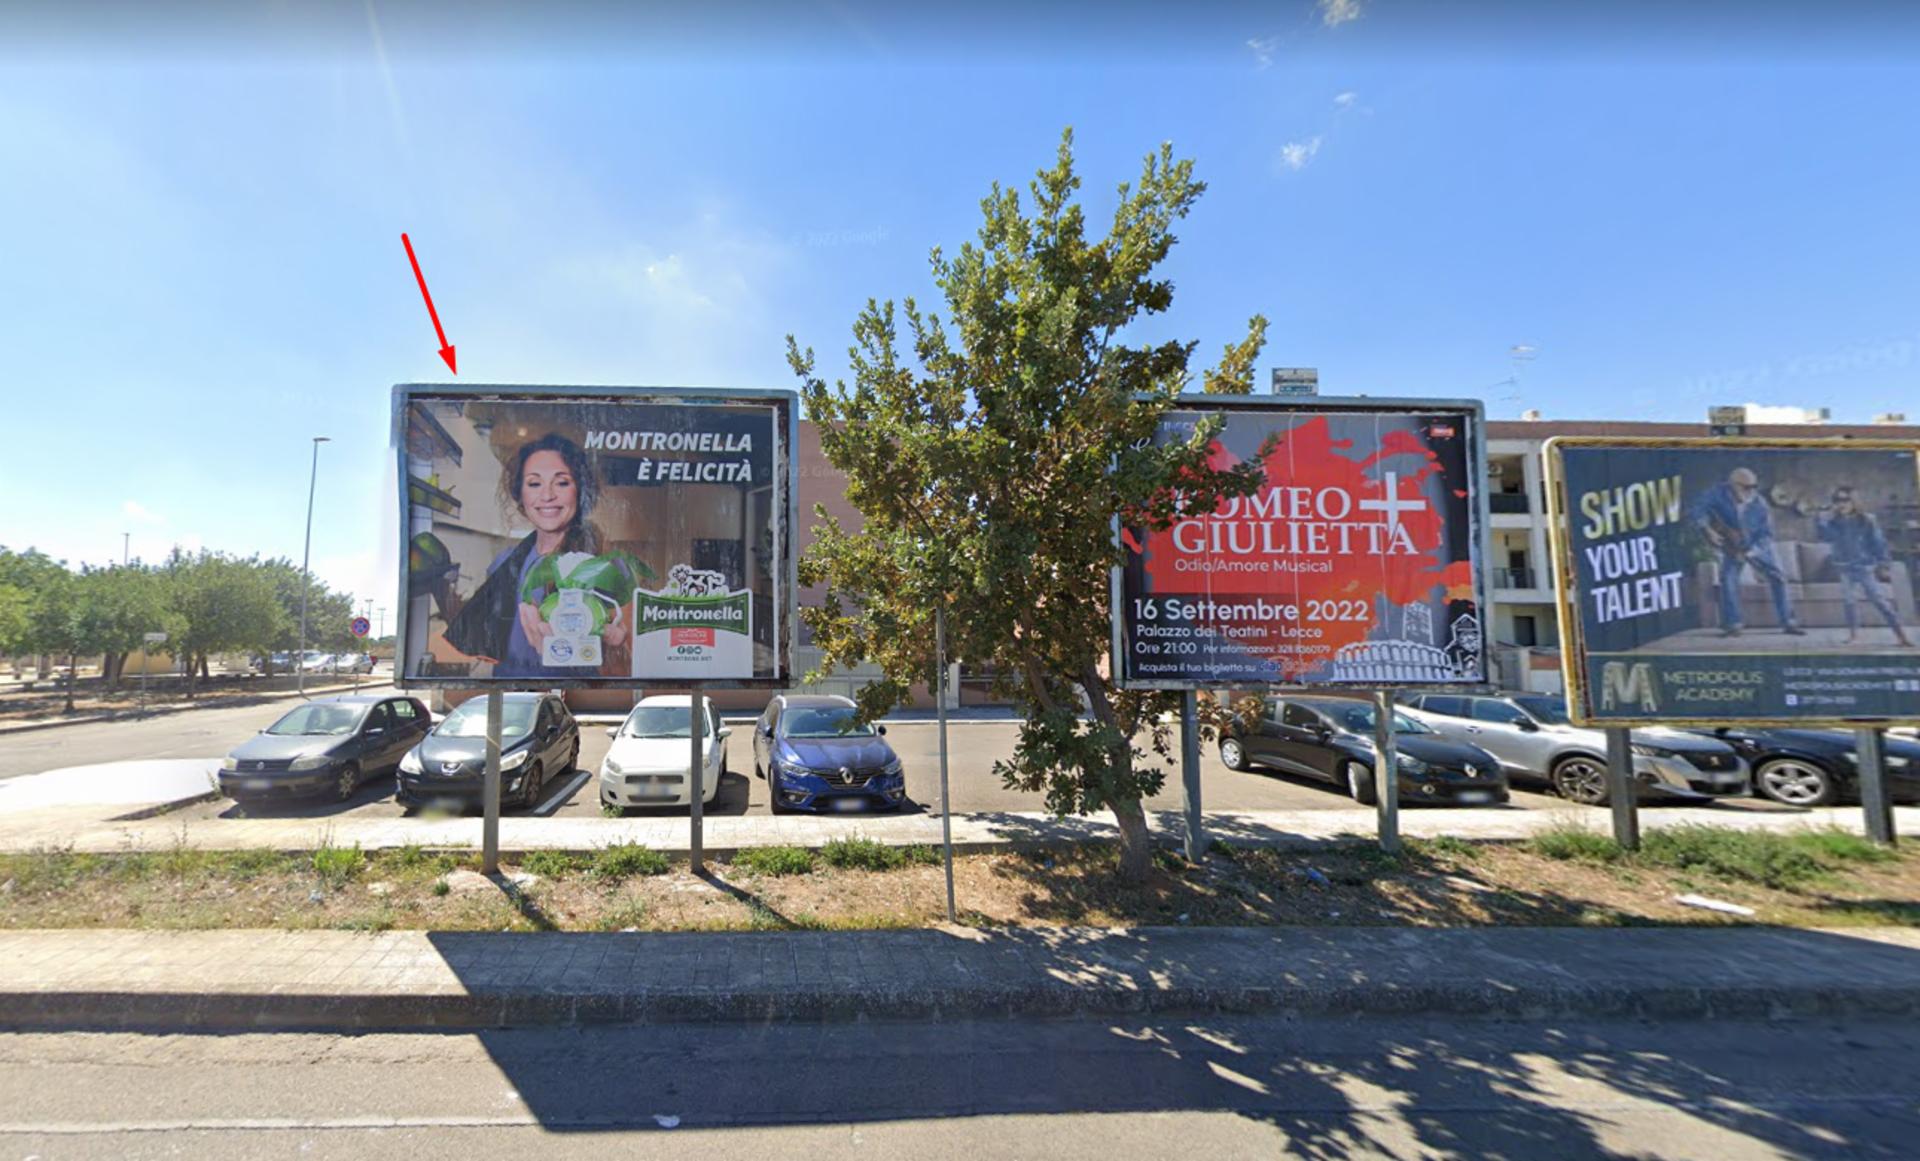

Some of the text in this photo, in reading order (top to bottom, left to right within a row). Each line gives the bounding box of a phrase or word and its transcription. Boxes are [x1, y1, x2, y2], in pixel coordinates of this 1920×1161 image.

[584, 431, 753, 453] MONTRONELLA
[637, 458, 651, 482] È
[656, 458, 753, 482] FELICITÀ
[1175, 487, 1351, 520] OMEO
[1580, 475, 1683, 541] SHOW
[1171, 521, 1420, 556] GIULIETTA
[1273, 558, 1334, 573] Musical
[1585, 536, 1658, 582] YOUR
[1590, 571, 1684, 624] TALENT
[642, 605, 743, 622] Montronella
[1134, 599, 1369, 622] 16 Settembre 2022
[1136, 624, 1191, 638] Palazzo
[1220, 624, 1268, 638] Teatini
[1281, 625, 1324, 638] Lecce
[1135, 641, 1160, 655] Ore
[1663, 670, 1765, 685] METROPOLIS
[1675, 687, 1755, 702] ACADEMY
